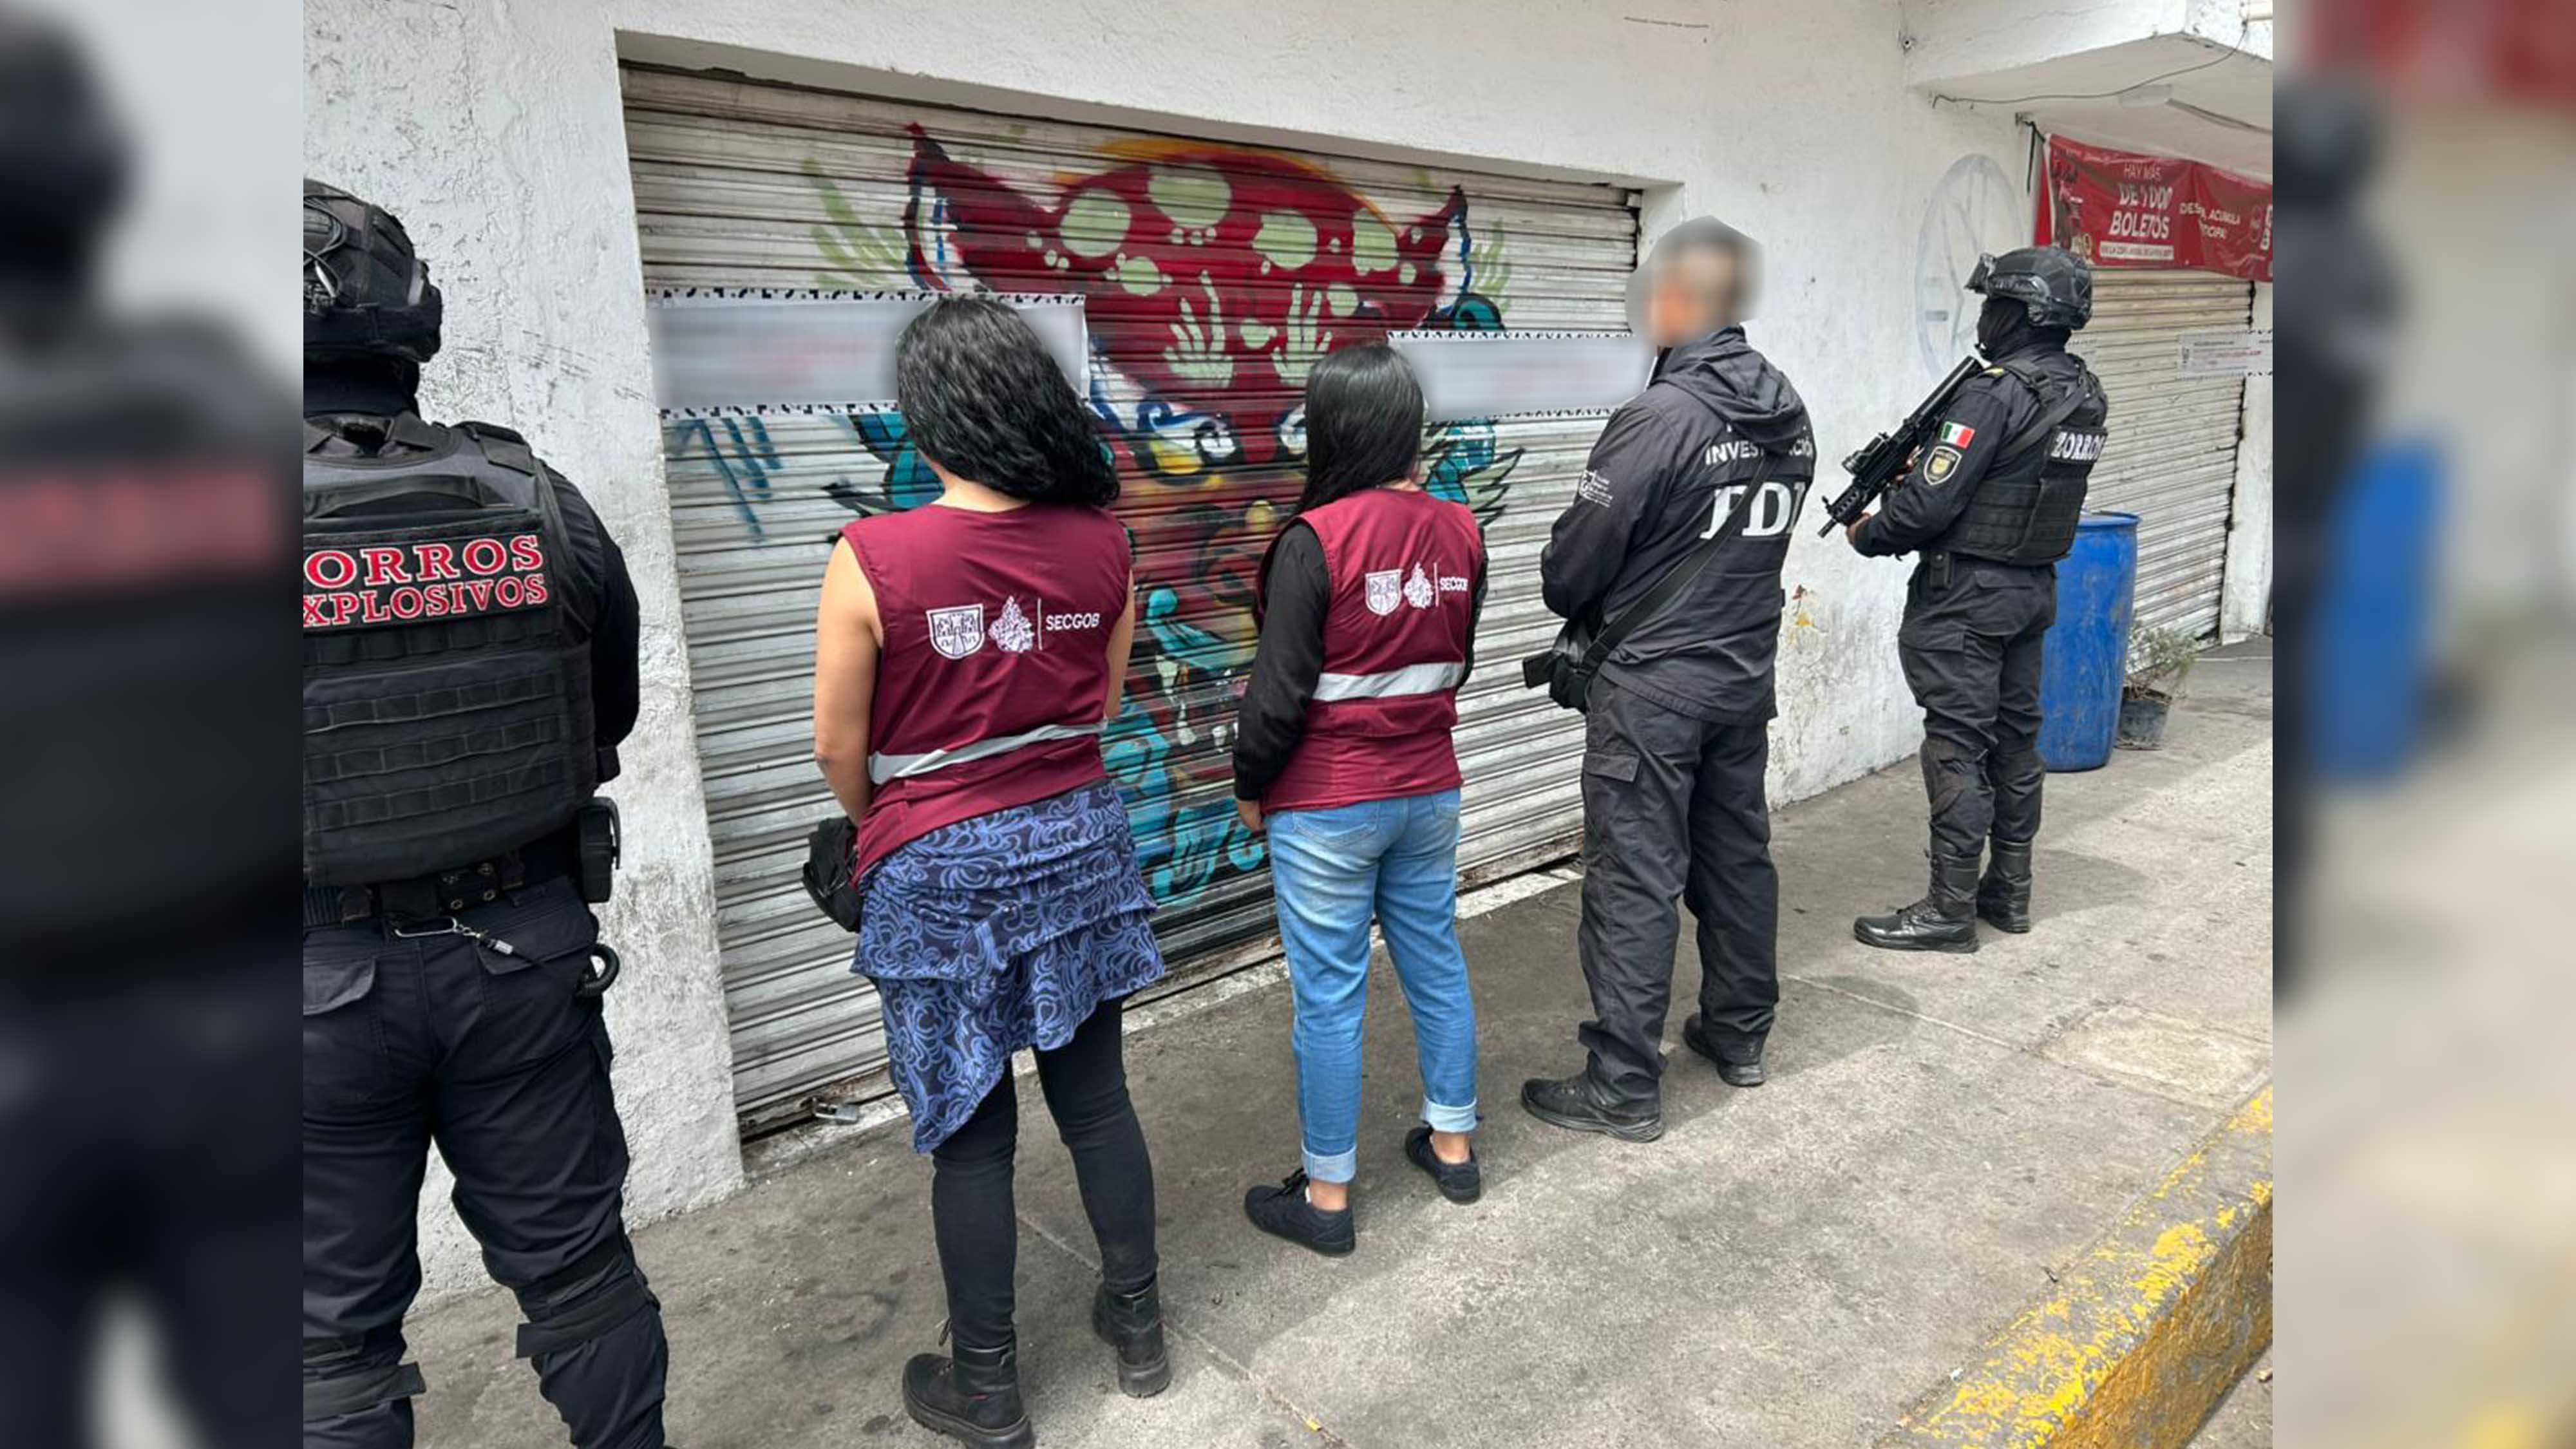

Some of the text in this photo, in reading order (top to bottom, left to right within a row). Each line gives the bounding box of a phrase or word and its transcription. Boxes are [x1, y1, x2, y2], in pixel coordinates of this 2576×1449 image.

[2109, 211, 2170, 239] BOLETOS
[304, 535, 544, 589] ORROS
[303, 574, 549, 628] XPLOSIVOS
[1045, 612, 1100, 631] SECGOB
